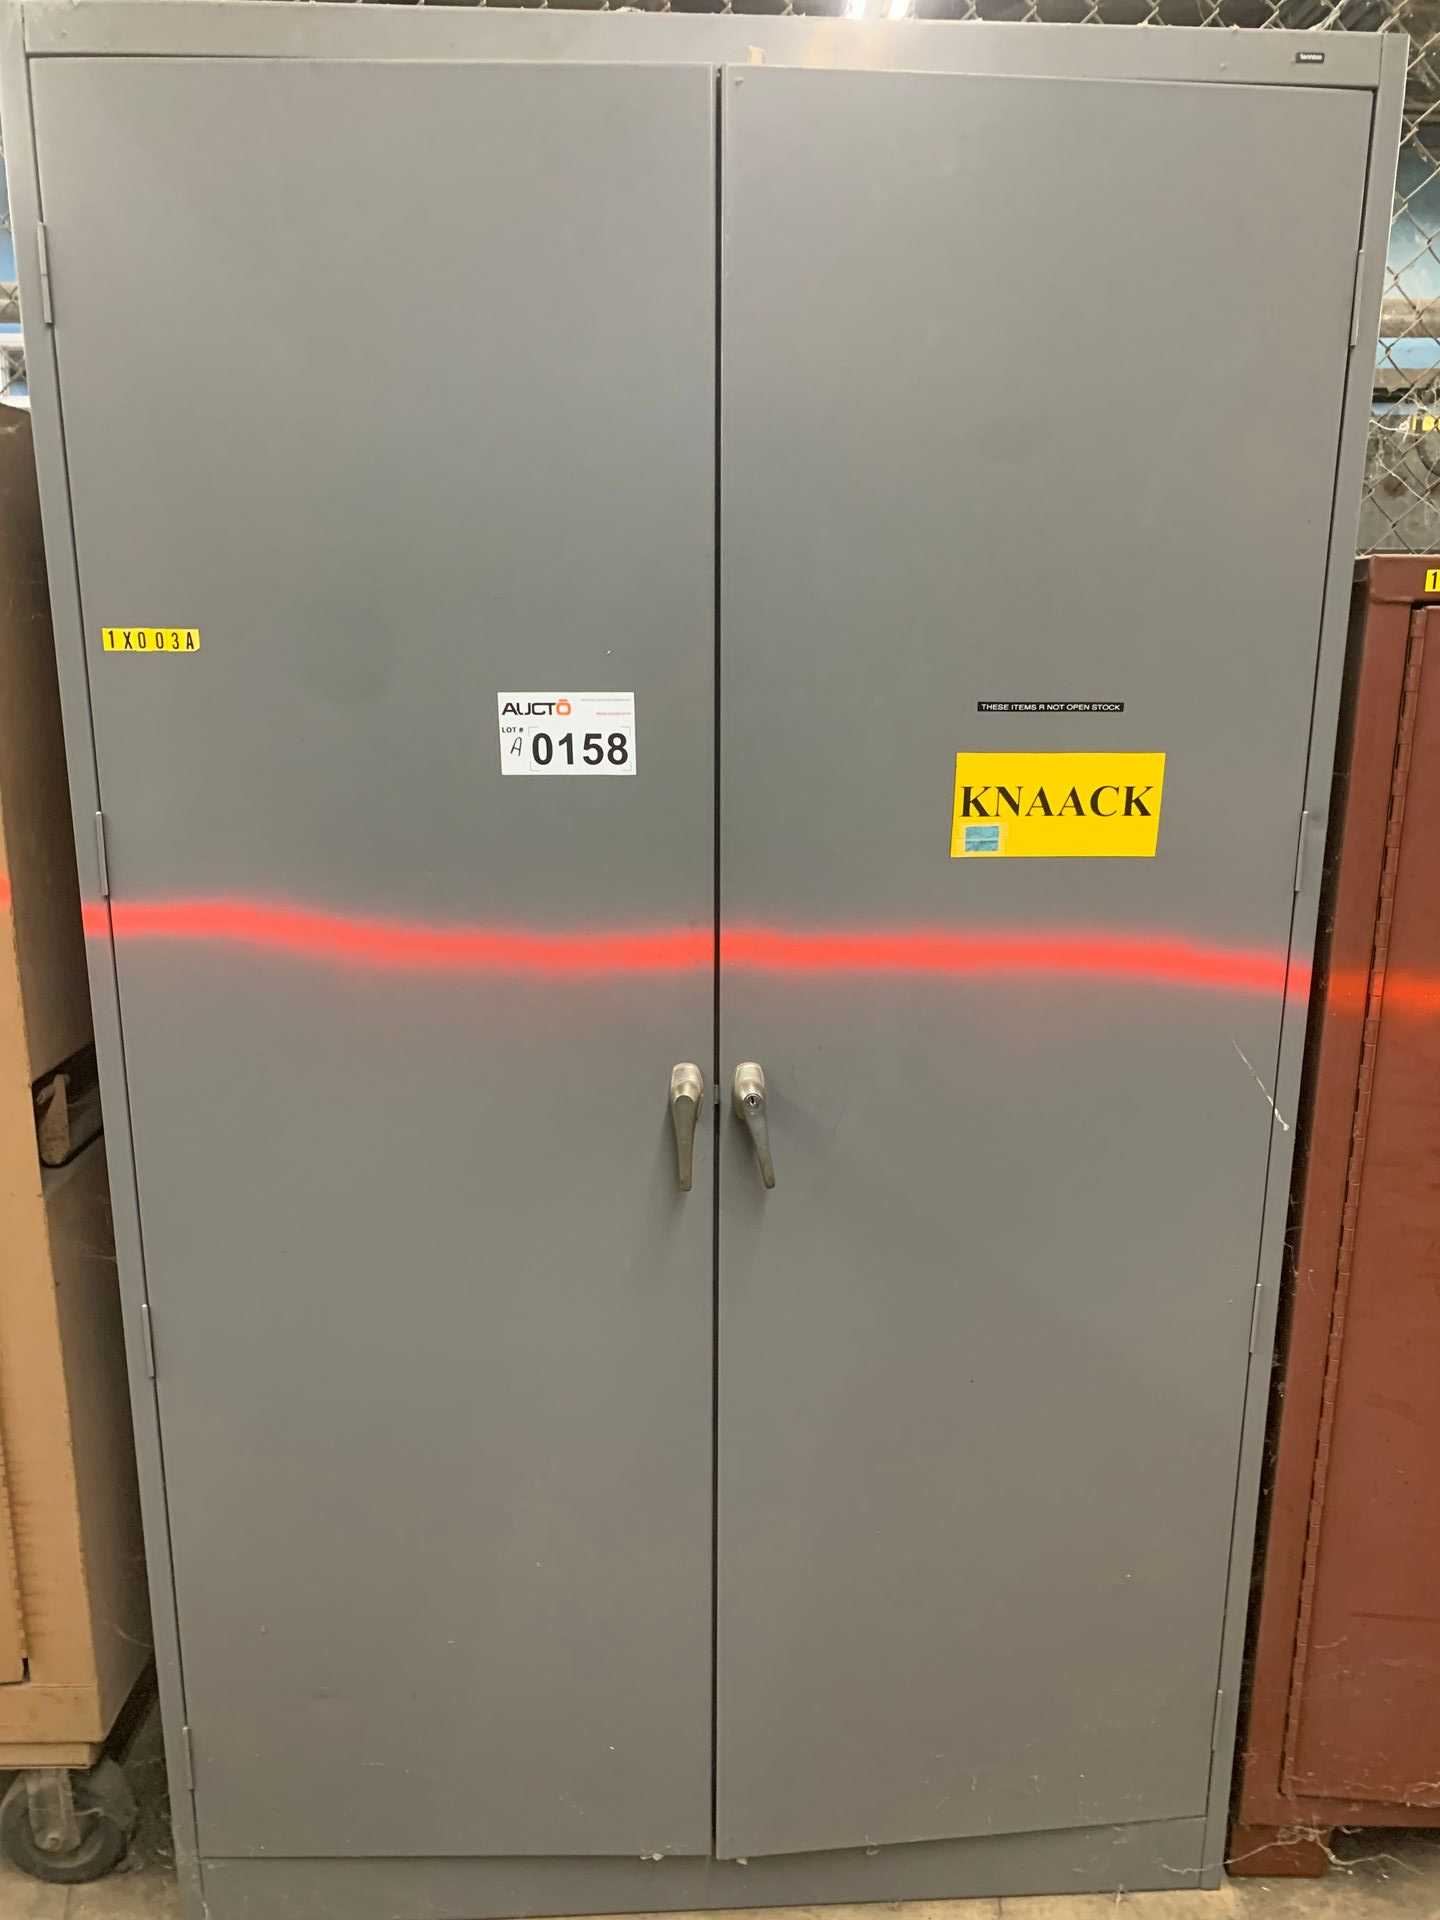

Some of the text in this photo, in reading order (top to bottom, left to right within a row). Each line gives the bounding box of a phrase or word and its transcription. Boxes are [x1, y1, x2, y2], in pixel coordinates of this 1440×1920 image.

[107, 630, 195, 650] 1X003A
[981, 703, 1010, 711] THESE
[1011, 703, 1037, 711] ITEMS
[1046, 703, 1066, 711] NOT
[1066, 703, 1090, 711] OPEN
[1091, 703, 1121, 711] STOCK
[510, 736, 523, 757] A
[532, 732, 629, 766] 0158
[960, 785, 1154, 818] KNAACK
